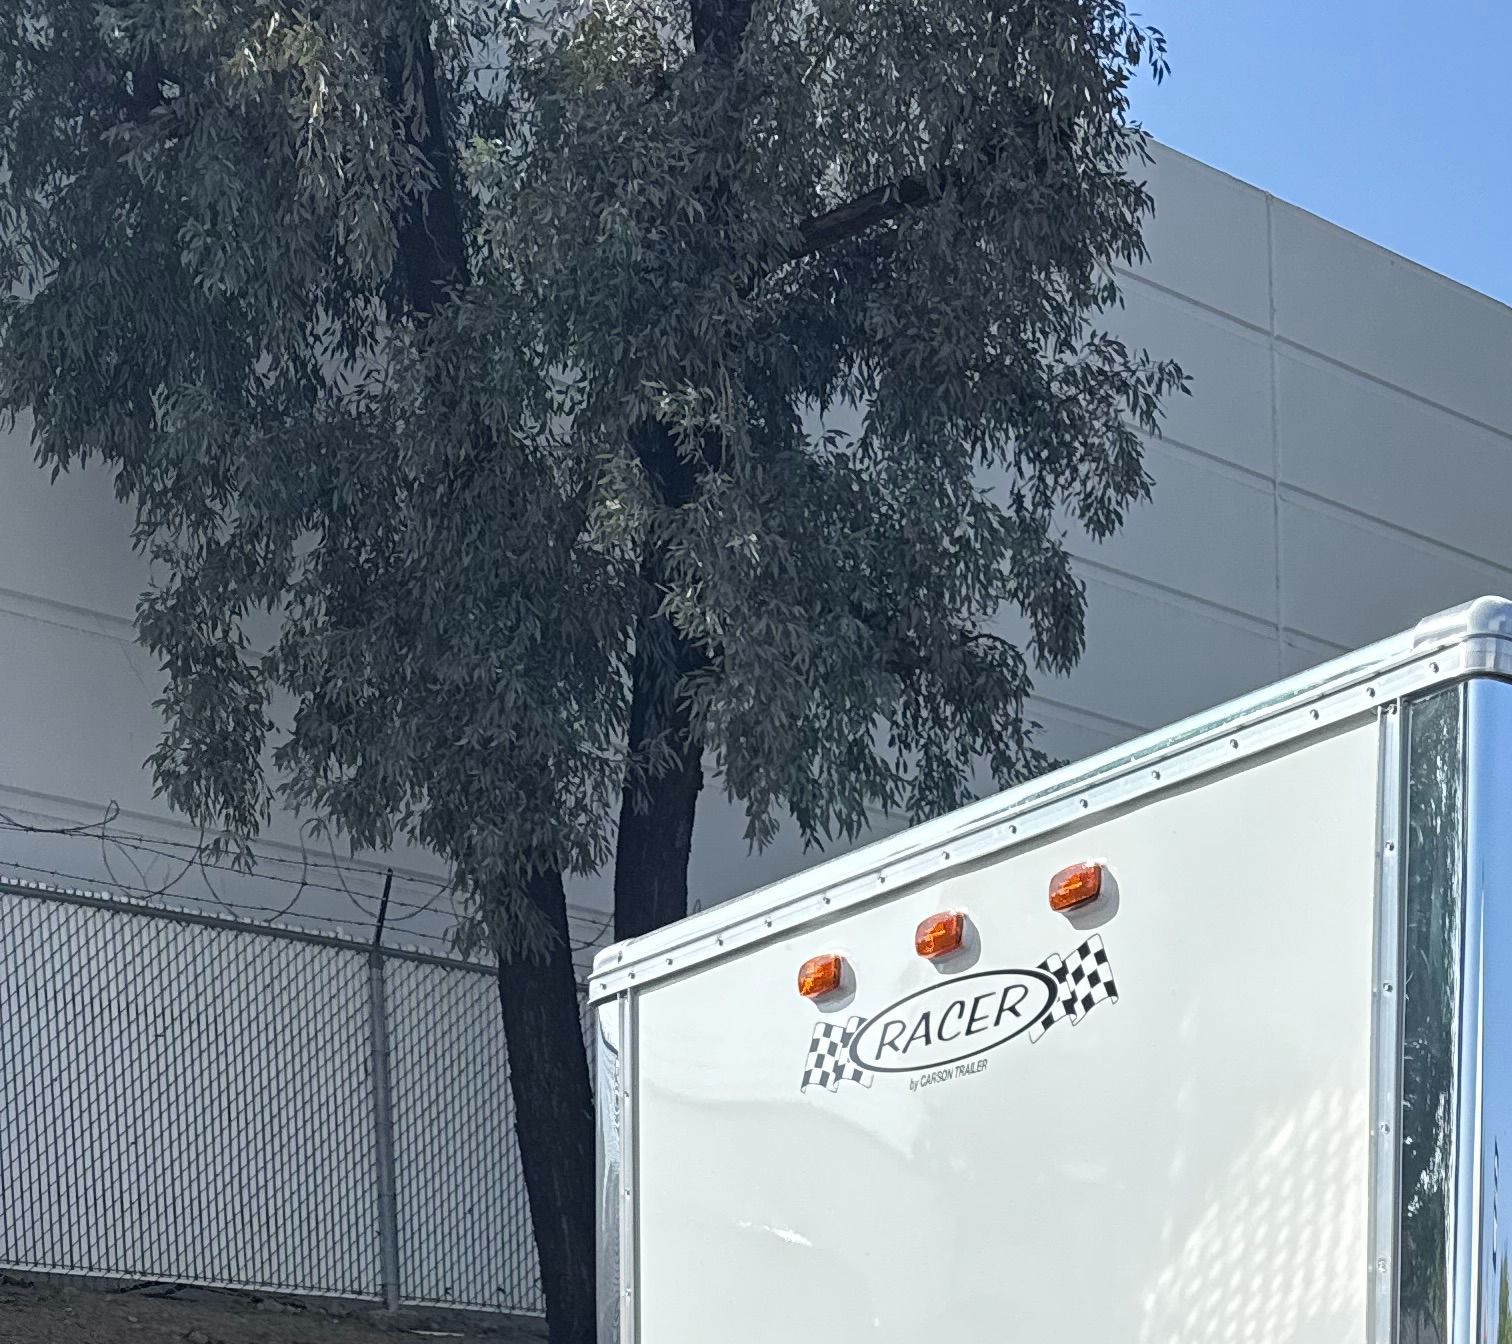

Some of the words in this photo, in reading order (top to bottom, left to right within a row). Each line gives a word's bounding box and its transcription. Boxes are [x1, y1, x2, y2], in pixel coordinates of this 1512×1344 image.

[875, 983, 1029, 1061] RACER
[909, 1077, 919, 1092] by
[920, 1068, 954, 1087] CARSON
[955, 1058, 988, 1079] TRAILER
